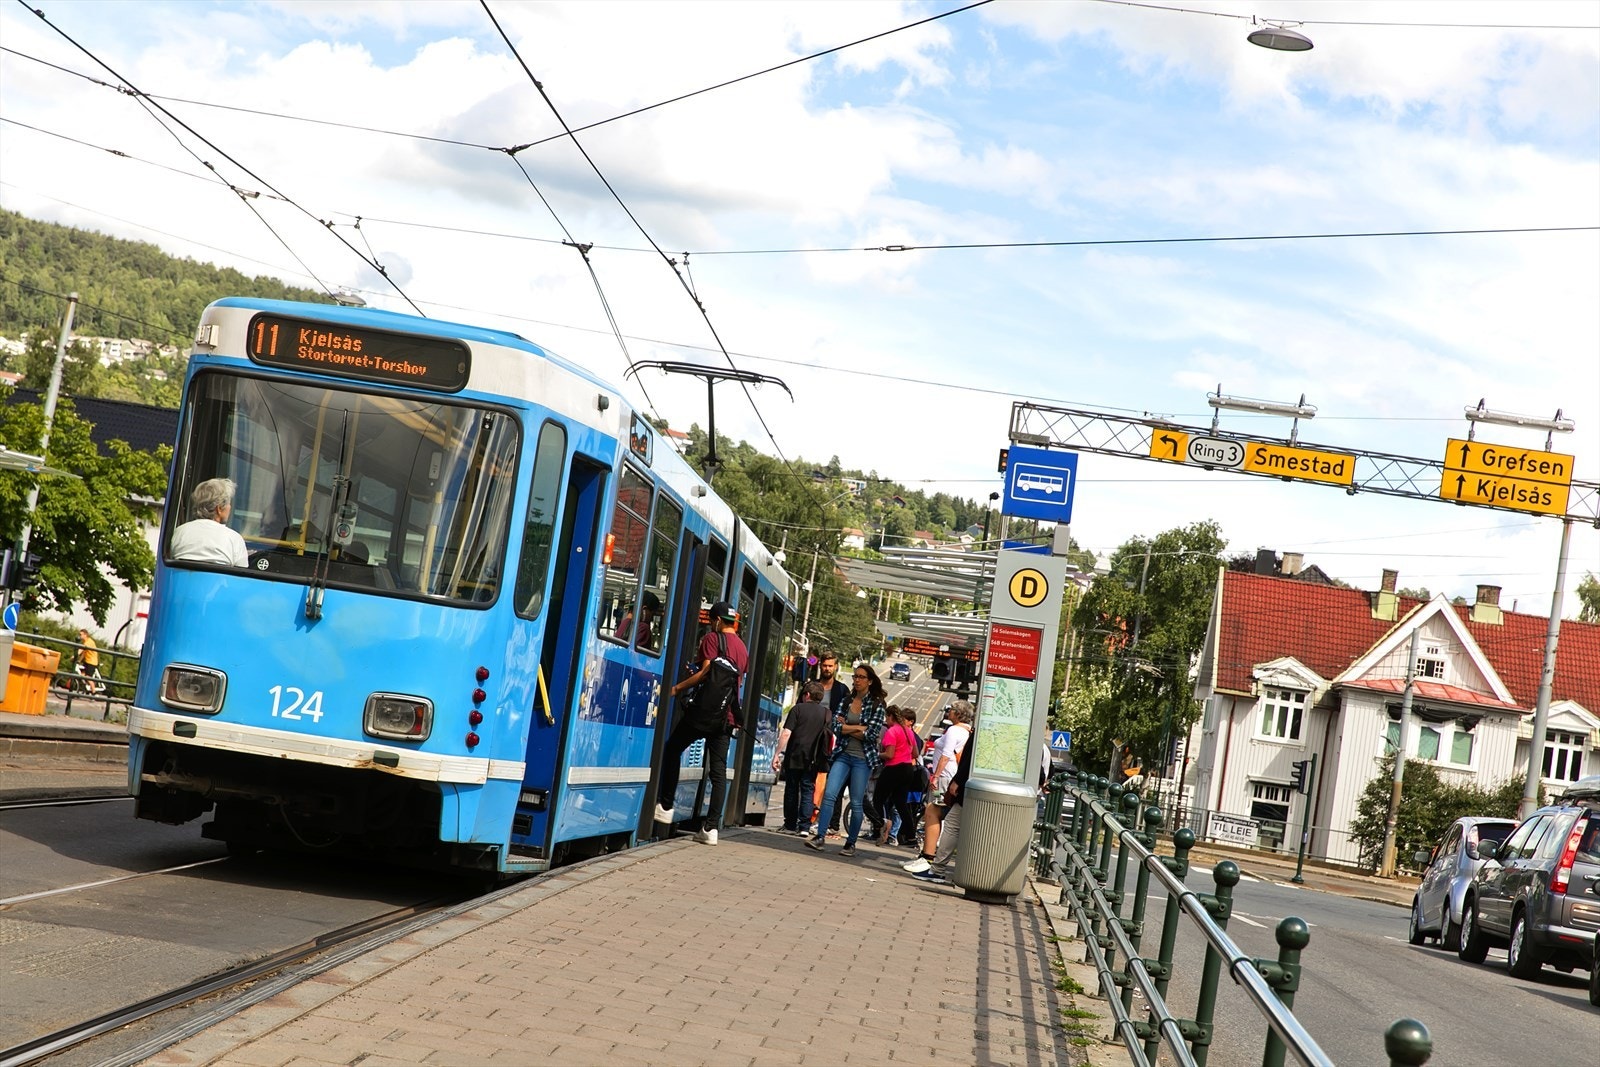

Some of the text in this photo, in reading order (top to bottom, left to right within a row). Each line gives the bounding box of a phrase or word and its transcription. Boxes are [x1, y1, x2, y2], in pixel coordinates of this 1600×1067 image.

[255, 322, 363, 356] 11 Kjelsås
[298, 346, 427, 376] Stortorvet-Torshov
[1194, 443, 1345, 477] Ring 3 Smestad
[1482, 448, 1564, 477] Grefsen
[1476, 479, 1552, 506] Kjelsås
[1020, 576, 1038, 599] D
[268, 684, 324, 723] 124
[1214, 822, 1228, 833] TIL
[1230, 825, 1253, 837] LEIE
